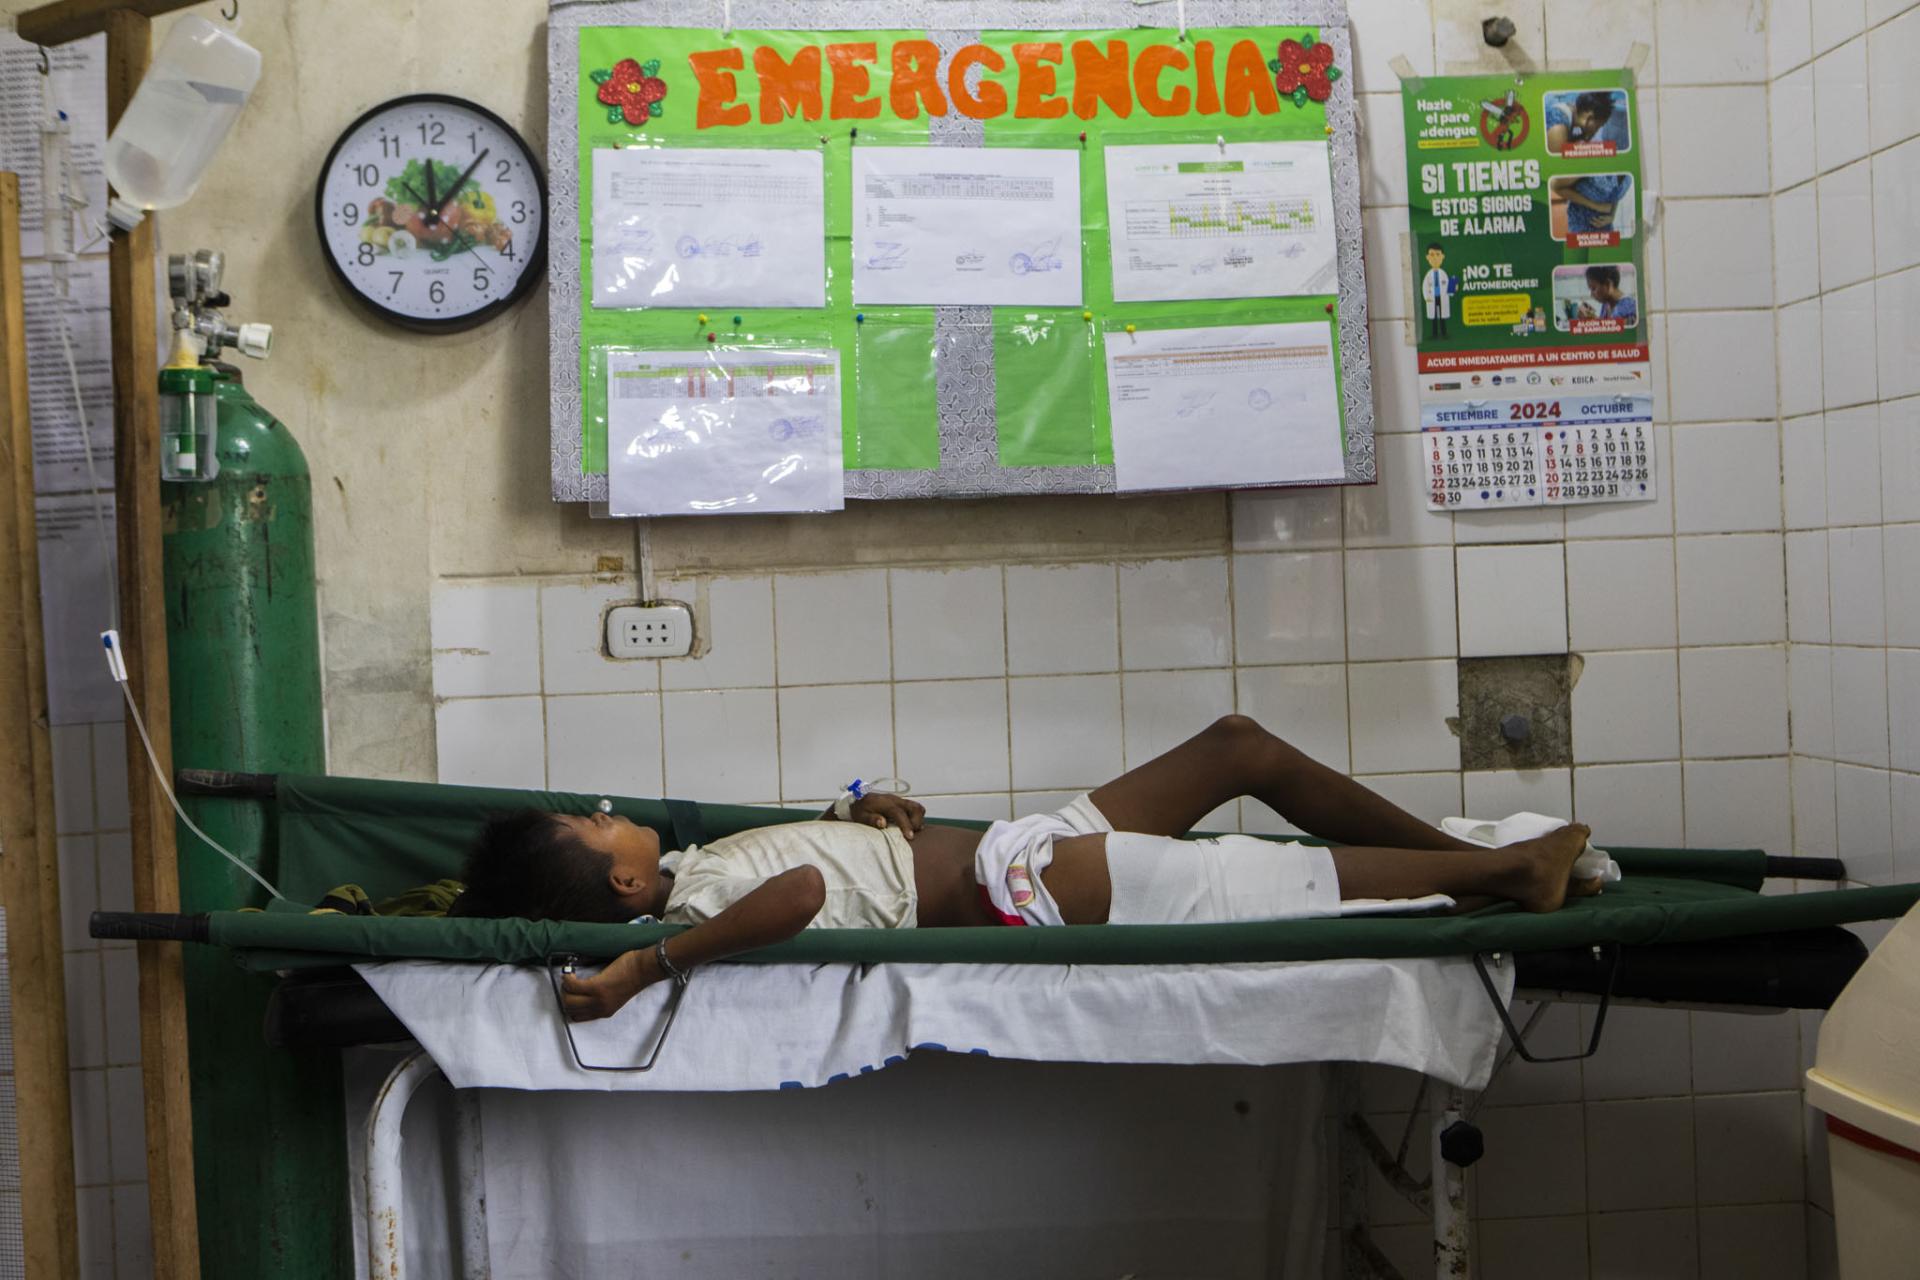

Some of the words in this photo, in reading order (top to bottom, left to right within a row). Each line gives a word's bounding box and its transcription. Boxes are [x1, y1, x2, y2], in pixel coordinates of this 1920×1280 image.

[690, 38, 1281, 129] EMERGENCIA
[1417, 99, 1452, 111] Hazle
[1426, 112, 1437, 124] el
[1440, 113, 1470, 127] pare
[418, 122, 445, 145] 12
[467, 132, 476, 154] 1
[1429, 126, 1477, 139] dengue
[380, 135, 399, 158] 11
[353, 164, 379, 186] 10
[496, 160, 511, 182] 2
[1421, 164, 1445, 193] SI
[1452, 159, 1540, 192] TIENES
[343, 203, 358, 226] 9
[511, 201, 526, 224] 3
[1432, 198, 1478, 216] ESTOS
[1481, 194, 1532, 214] SIGNOS
[1440, 219, 1459, 236] DE
[1463, 215, 1526, 235] ALARMA
[358, 242, 375, 266] 8
[500, 239, 516, 261] 4
[388, 272, 403, 294] 7
[473, 268, 489, 290] 5
[1463, 265, 1490, 281] ¡NO
[1493, 264, 1513, 278] TE
[430, 281, 445, 303] 6
[1463, 279, 1539, 291] AUTOMEDIQUES!
[1427, 358, 1457, 368] ACUDE
[1458, 354, 1535, 366] INMEDIATAMENTE
[1537, 353, 1545, 362] A
[1545, 353, 1559, 361] UN
[1560, 351, 1596, 360] CENTRO
[1597, 350, 1610, 359] DE
[1611, 349, 1640, 358] SALUD
[1436, 409, 1499, 422] SETIEMBRE
[1509, 401, 1562, 420] 2024
[1581, 403, 1634, 415] OCTUBRE
[1432, 437, 1437, 446] 1
[1447, 436, 1453, 446] 2
[1462, 435, 1468, 445] 3
[1477, 435, 1484, 444] 4
[1493, 434, 1499, 444] 5
[1508, 433, 1515, 443] 6
[1523, 432, 1529, 442] 7
[1576, 430, 1581, 439] 1
[1591, 429, 1597, 439] 2
[1606, 428, 1612, 438] 3
[1621, 428, 1627, 437] 4
[1636, 427, 1642, 437] 5
[1433, 451, 1440, 461] 8
[1448, 450, 1455, 460] 9
[1460, 449, 1472, 459] 10
[1477, 449, 1485, 458] 11
[1492, 448, 1502, 457] 12
[1506, 447, 1517, 457] 13
[1522, 447, 1533, 456] 14
[1547, 445, 1553, 455] 6
[1562, 444, 1568, 454] 7
[1577, 444, 1583, 453] 8
[1592, 443, 1598, 453] 9
[1605, 442, 1616, 452] 10
[1621, 442, 1629, 451] 11
[1635, 441, 1645, 451] 12
[1432, 465, 1443, 475] 15
[1448, 464, 1459, 474] 16
[1462, 464, 1472, 472] 17
[1477, 463, 1488, 472] 18
[1492, 462, 1503, 472] 19
[1506, 461, 1519, 471] 20
[1523, 461, 1533, 470] 21
[1546, 459, 1556, 469] 13
[1560, 459, 1572, 468] 14
[1576, 458, 1586, 467] 15
[1590, 457, 1602, 467] 16
[1606, 456, 1616, 466] 17
[1621, 456, 1631, 465] 18
[1636, 455, 1646, 464] 19
[1432, 479, 1445, 489] 22
[1448, 478, 1460, 488] 23
[1462, 477, 1476, 487] 24
[1478, 477, 1490, 486] 25
[1493, 476, 1506, 485] 26
[1508, 475, 1520, 485] 27
[1523, 474, 1536, 484] 28
[1546, 473, 1559, 483] 20
[1562, 473, 1572, 482] 21
[1576, 472, 1588, 481] 22
[1591, 471, 1603, 481] 23
[1606, 470, 1618, 480] 24
[1621, 470, 1633, 479] 25
[1636, 469, 1647, 479] 26
[1432, 493, 1445, 503] 29
[1448, 492, 1461, 502] 30
[1547, 487, 1559, 497] 27
[1562, 486, 1575, 496] 28
[1577, 486, 1589, 495] 29
[1592, 485, 1604, 495] 30
[1608, 484, 1618, 494] 31
